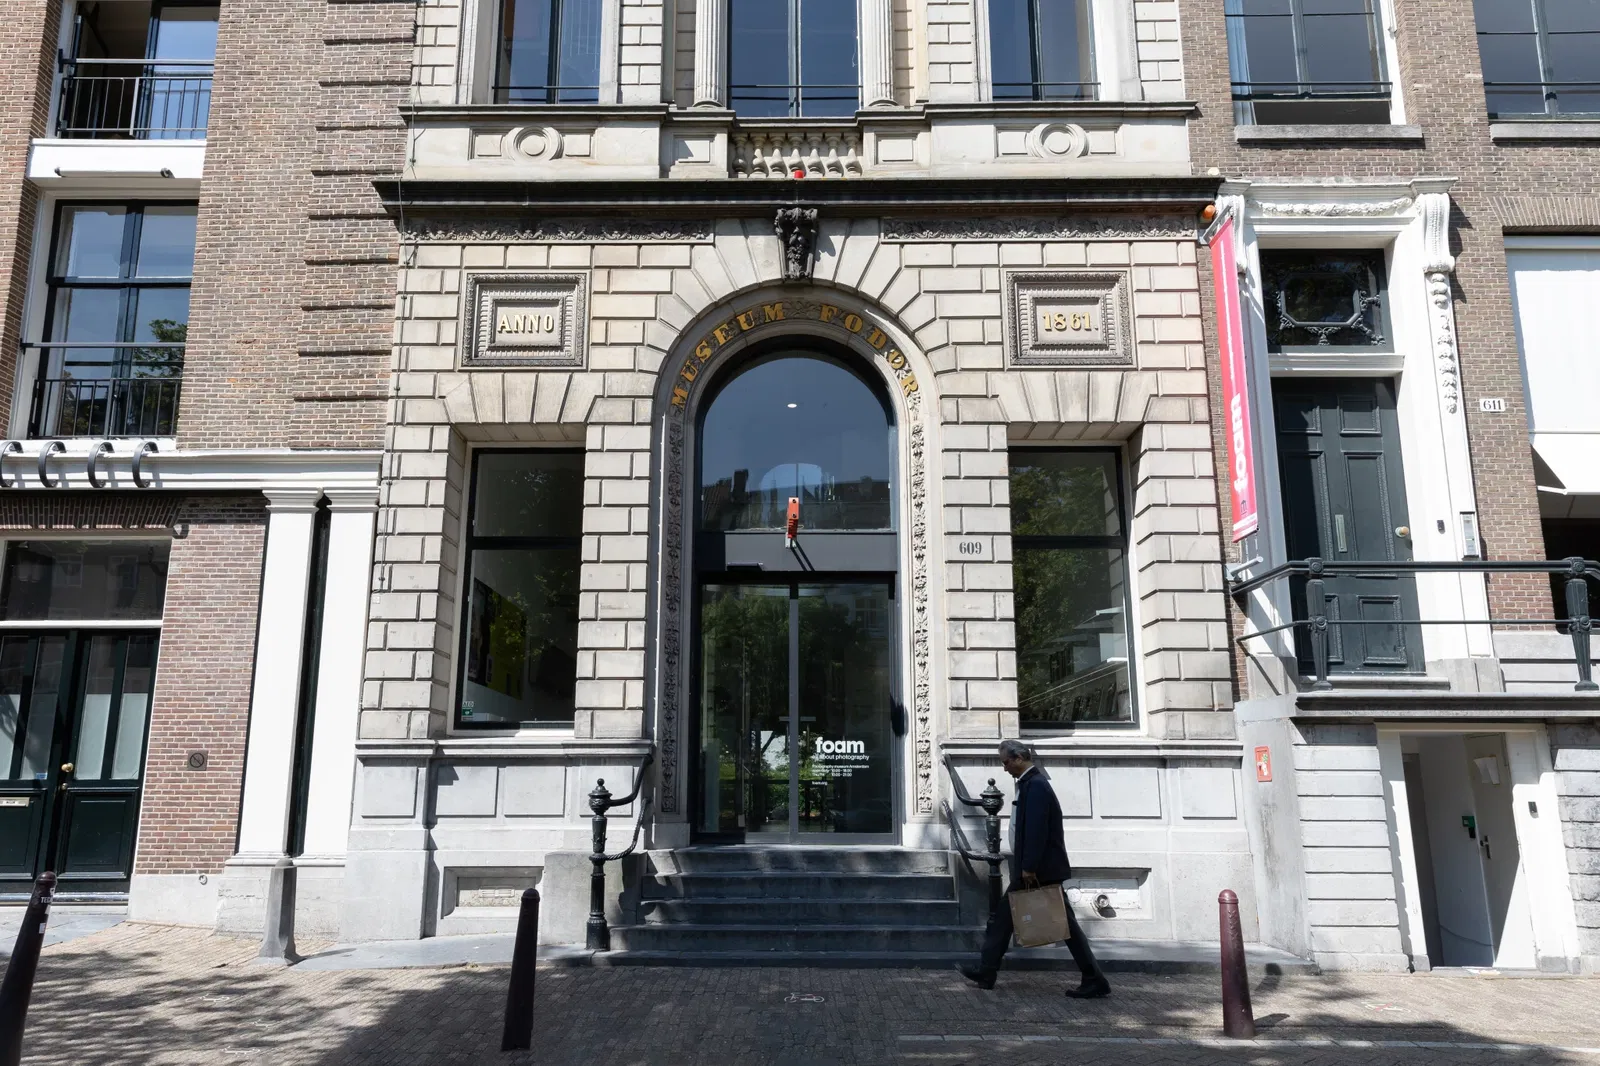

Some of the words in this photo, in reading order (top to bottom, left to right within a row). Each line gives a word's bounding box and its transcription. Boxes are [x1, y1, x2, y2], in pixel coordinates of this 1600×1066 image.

[497, 314, 555, 333] ANNO
[670, 302, 786, 410] MUSEUM
[818, 303, 919, 397] FODOR
[1483, 399, 1502, 410] 611
[1230, 392, 1249, 493] foam
[959, 541, 982, 555] 609
[815, 736, 864, 753] foam
